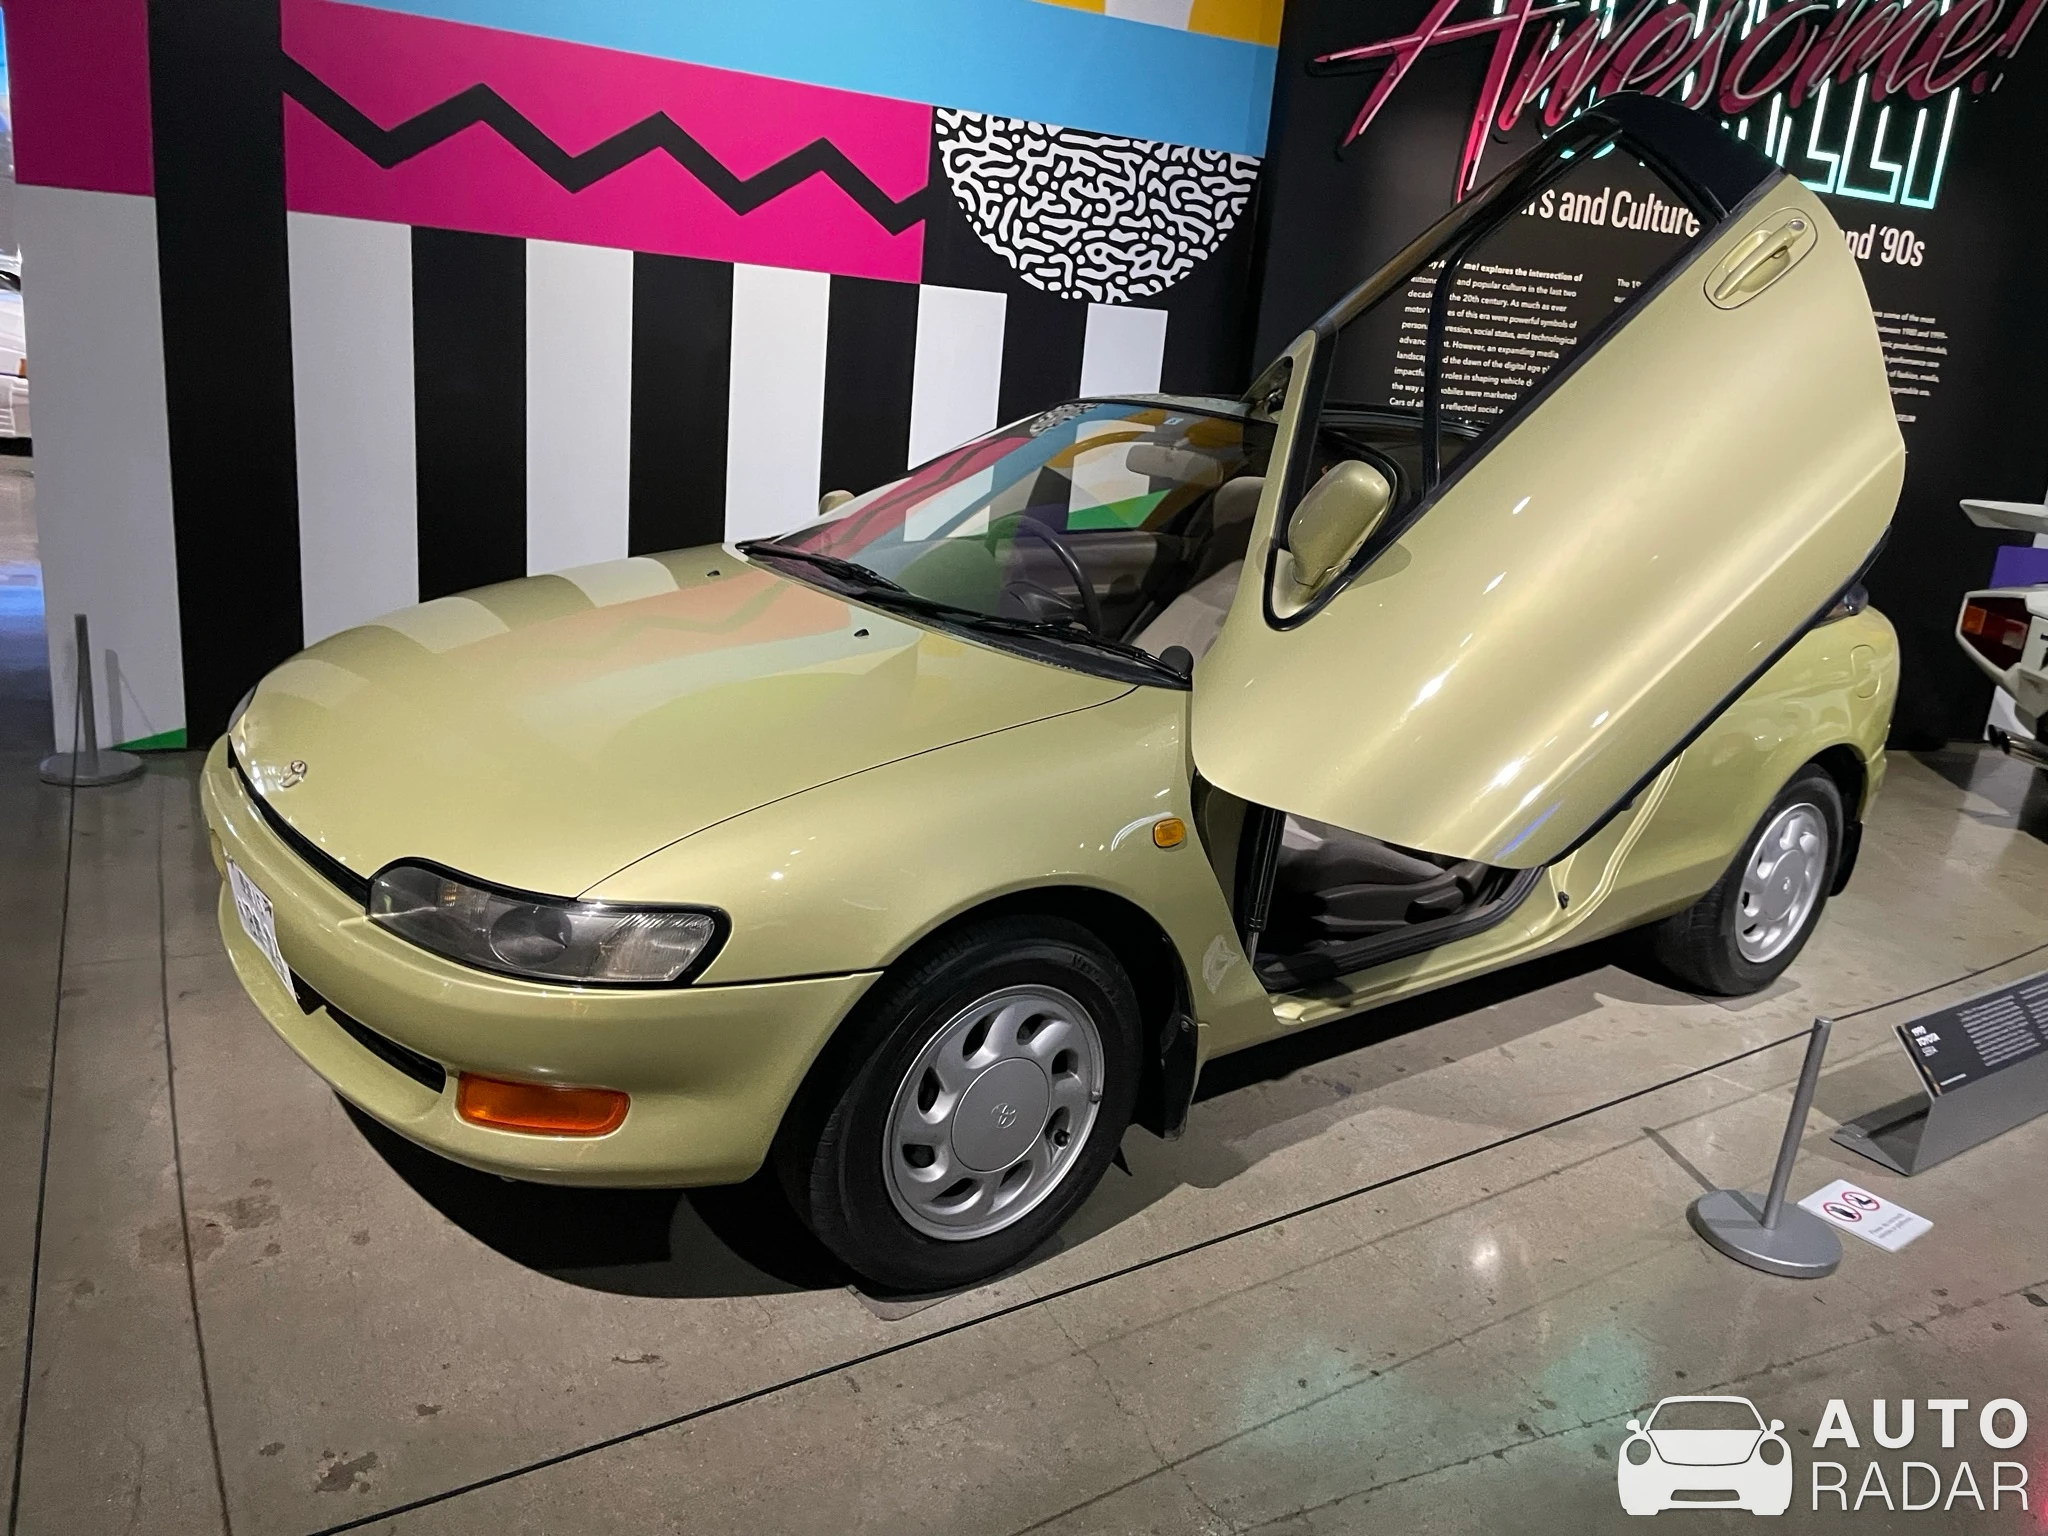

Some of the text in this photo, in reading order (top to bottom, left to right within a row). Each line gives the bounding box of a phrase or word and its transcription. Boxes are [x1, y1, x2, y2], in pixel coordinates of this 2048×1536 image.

[1558, 186, 1610, 226] and
[1611, 190, 1701, 238] Culture
[1840, 223, 1877, 260] nd
[1481, 264, 1514, 275] explores
[1515, 267, 1528, 277] the
[1528, 269, 1573, 281] intersection
[1573, 273, 1584, 282] of
[1456, 278, 1471, 287] and
[1472, 281, 1501, 290] popular
[1502, 283, 1527, 292] culture
[1527, 285, 1535, 293] in
[1536, 286, 1548, 295] the
[1549, 287, 1562, 296] last
[1563, 290, 1577, 298] two
[1617, 278, 1630, 288] The
[1449, 293, 1461, 302] the
[1462, 294, 1480, 303] 20th
[1481, 296, 1509, 308] century.
[1510, 299, 1520, 307] As
[1520, 301, 1540, 310] much
[1541, 303, 1550, 311] as
[1550, 304, 1567, 312] ever
[1404, 306, 1427, 314] motor
[1456, 309, 1465, 317] of
[1465, 310, 1478, 319] this
[1509, 316, 1540, 326] powerful
[1540, 319, 1568, 329] symbols
[1568, 320, 1578, 329] of
[1473, 328, 1494, 337] social
[1494, 330, 1515, 340] status,
[1516, 332, 1531, 341] and
[1531, 333, 1577, 346] technological
[1452, 340, 1486, 353] However,
[1487, 345, 1497, 353] an
[1497, 347, 1535, 358] expanding
[1536, 349, 1560, 359] media
[1449, 356, 1462, 365] the
[1462, 357, 1482, 367] dawn
[1482, 359, 1492, 367] of
[1491, 360, 1503, 369] the
[1504, 361, 1527, 372] digital
[1527, 365, 1541, 374] age
[1445, 372, 1463, 381] roles
[1463, 373, 1471, 381] in
[1471, 373, 1499, 386] shaping
[1500, 376, 1525, 386] vehicle
[1391, 382, 1404, 391] the
[1404, 385, 1420, 394] way
[1464, 388, 1483, 397] were
[1483, 390, 1518, 401] marketed
[1389, 397, 1406, 407] Cars
[1406, 398, 1415, 407] of
[1445, 403, 1477, 413] reflected
[1477, 405, 1498, 414] social
